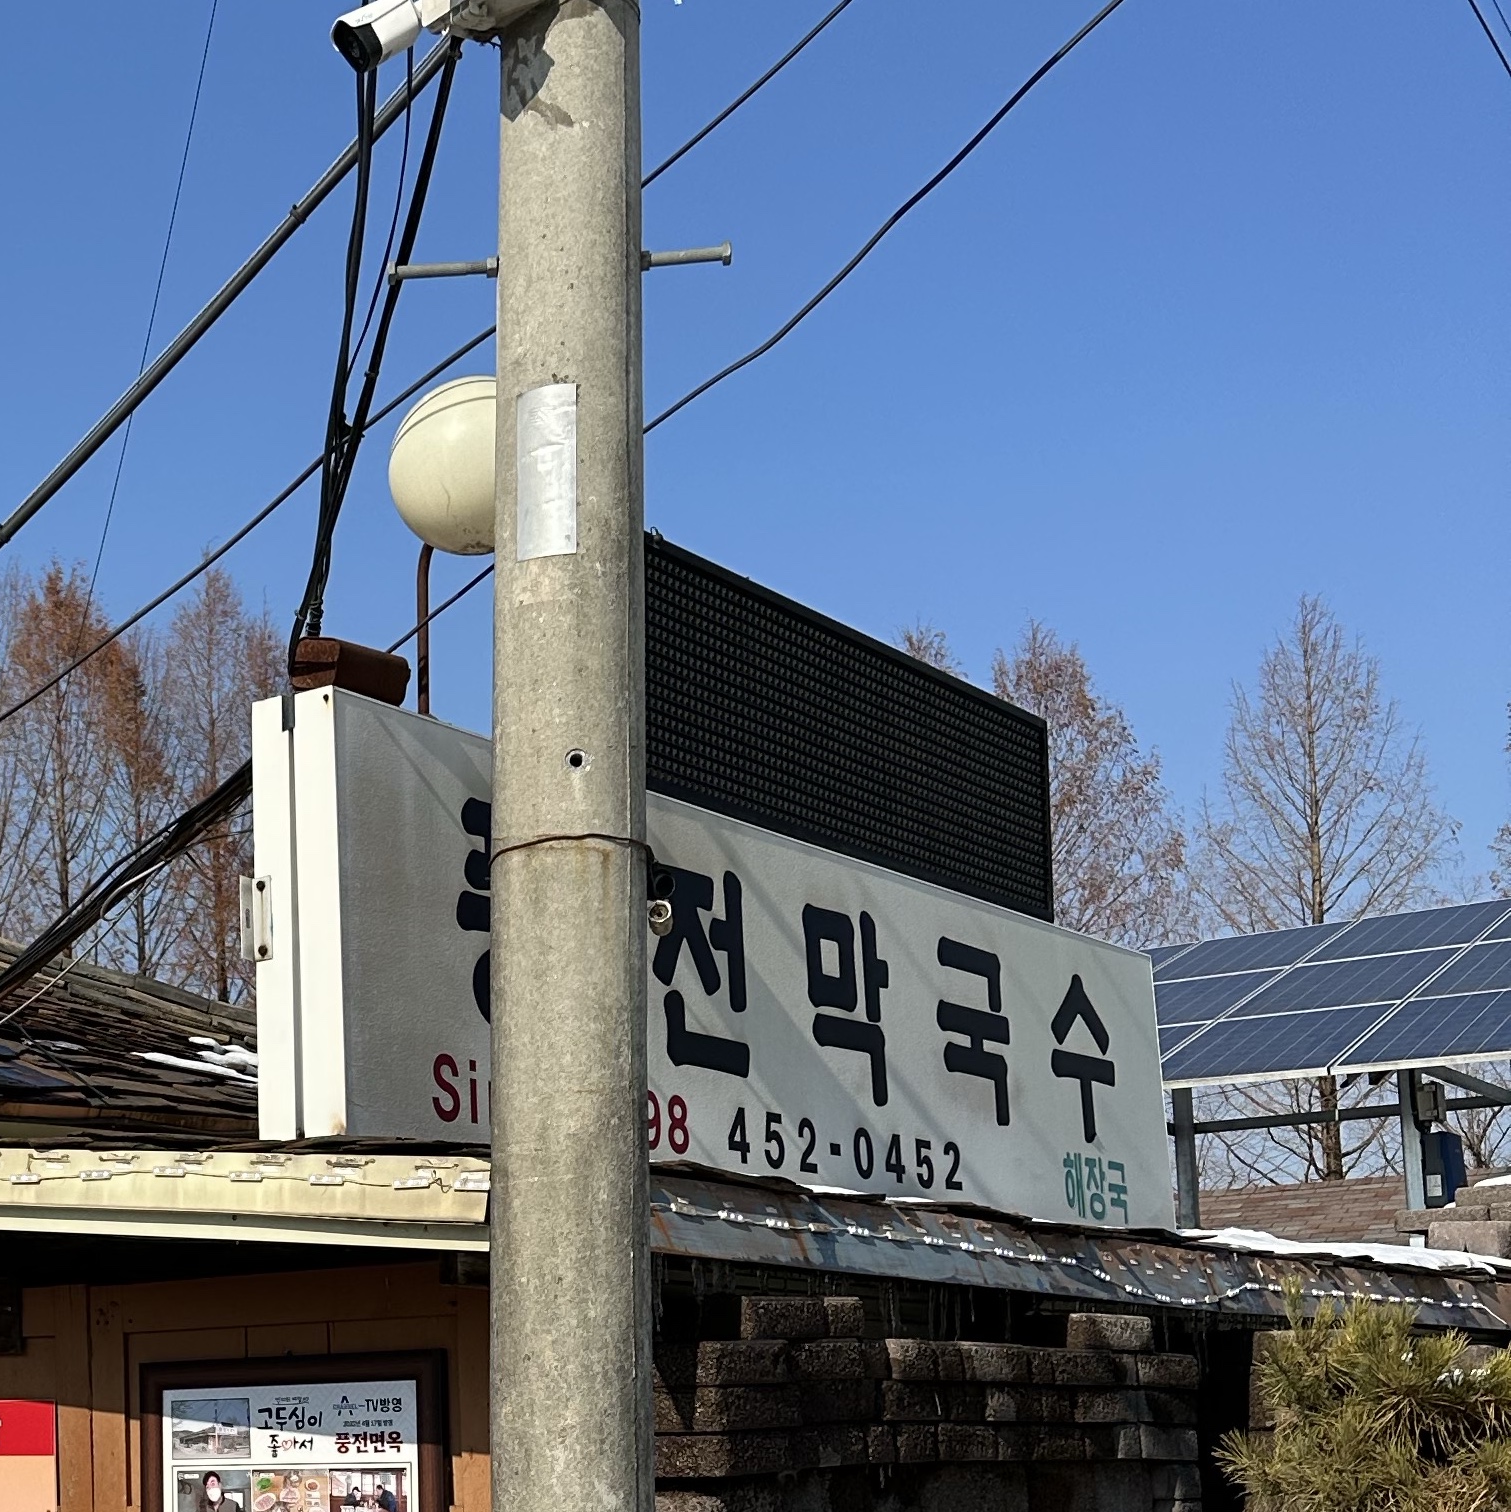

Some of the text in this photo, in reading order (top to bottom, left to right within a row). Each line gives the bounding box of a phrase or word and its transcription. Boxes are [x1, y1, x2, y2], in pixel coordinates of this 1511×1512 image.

[728, 1107, 963, 1191] 452-0452
[1062, 1152, 1129, 1225] 해장국
[257, 1406, 323, 1431] 고두심이
[335, 1431, 403, 1453] 풍전면옥
